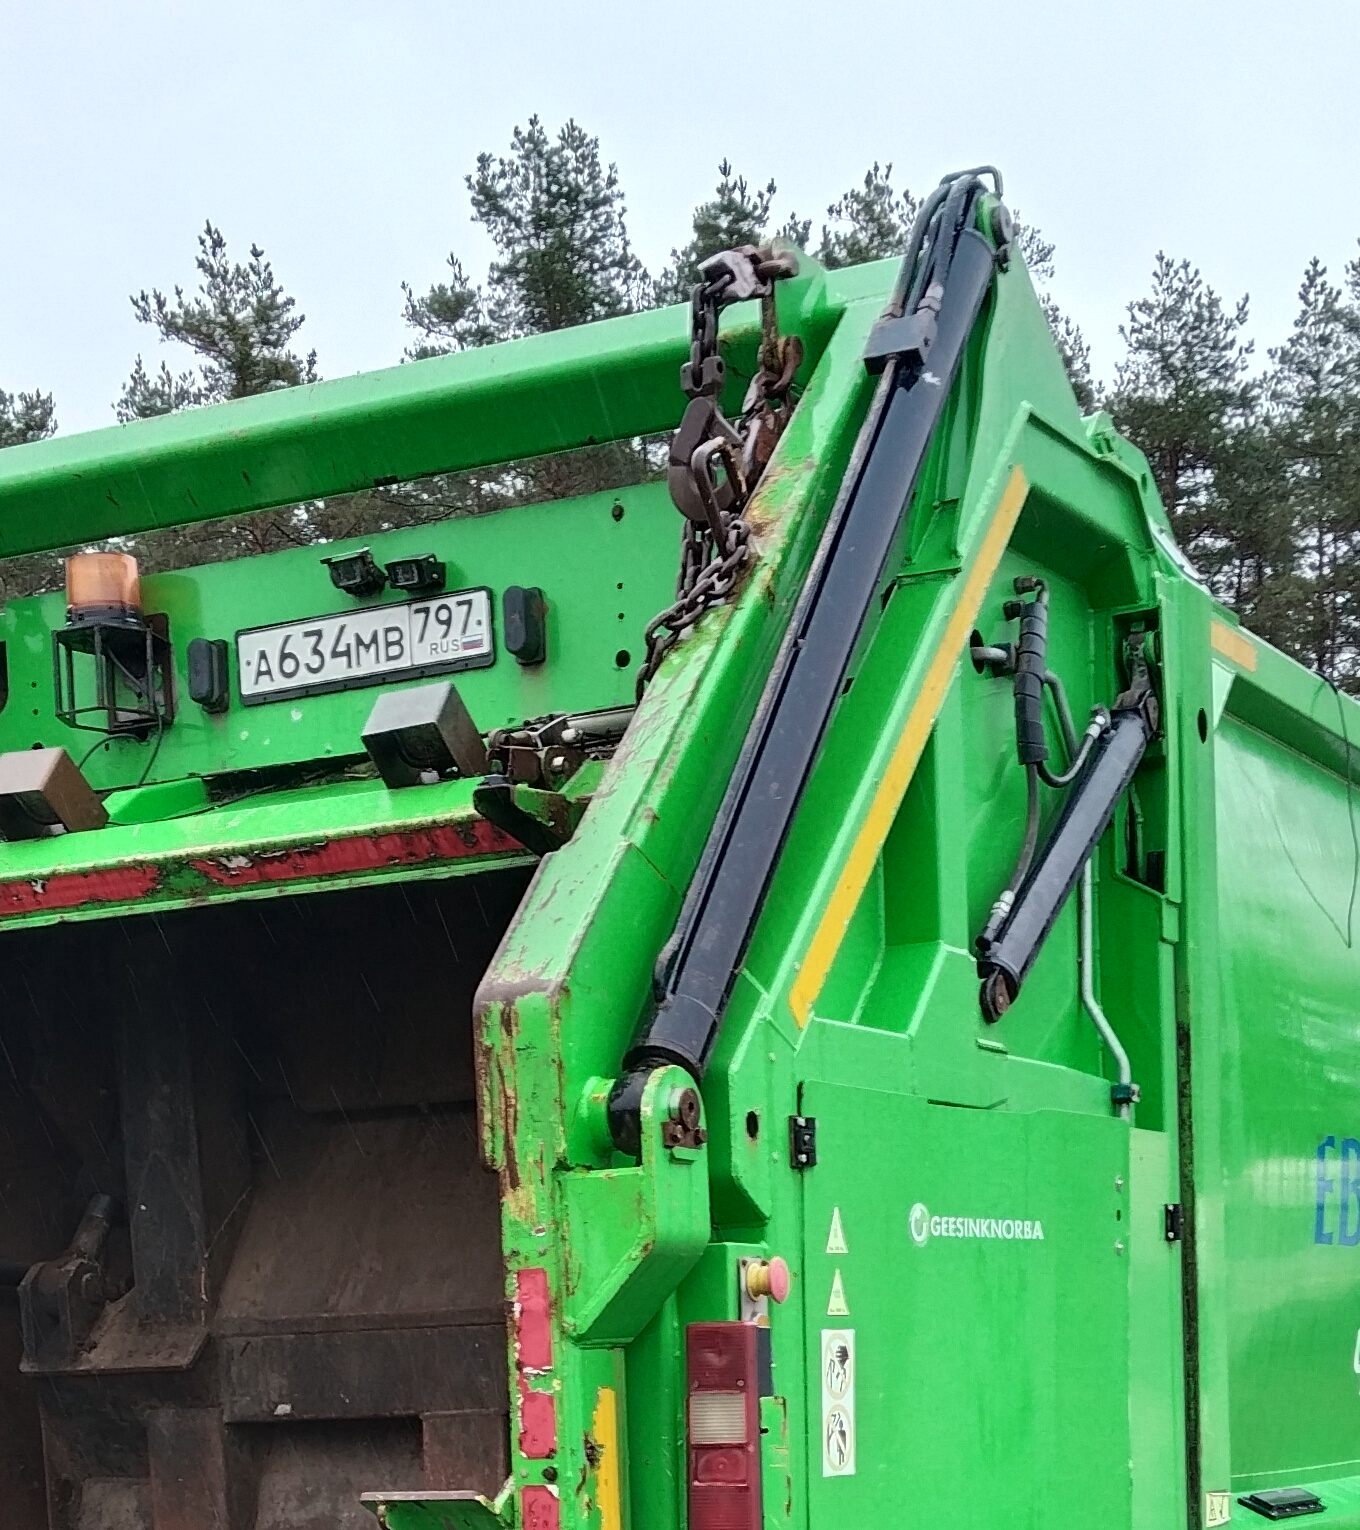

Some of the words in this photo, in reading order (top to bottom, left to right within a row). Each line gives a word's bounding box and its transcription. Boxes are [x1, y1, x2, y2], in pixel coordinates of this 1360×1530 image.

[253, 624, 404, 685] А634МВ
[414, 599, 473, 643] 797
[429, 641, 460, 655] RUS
[931, 1216, 1044, 1240] GEESINKNORBA
